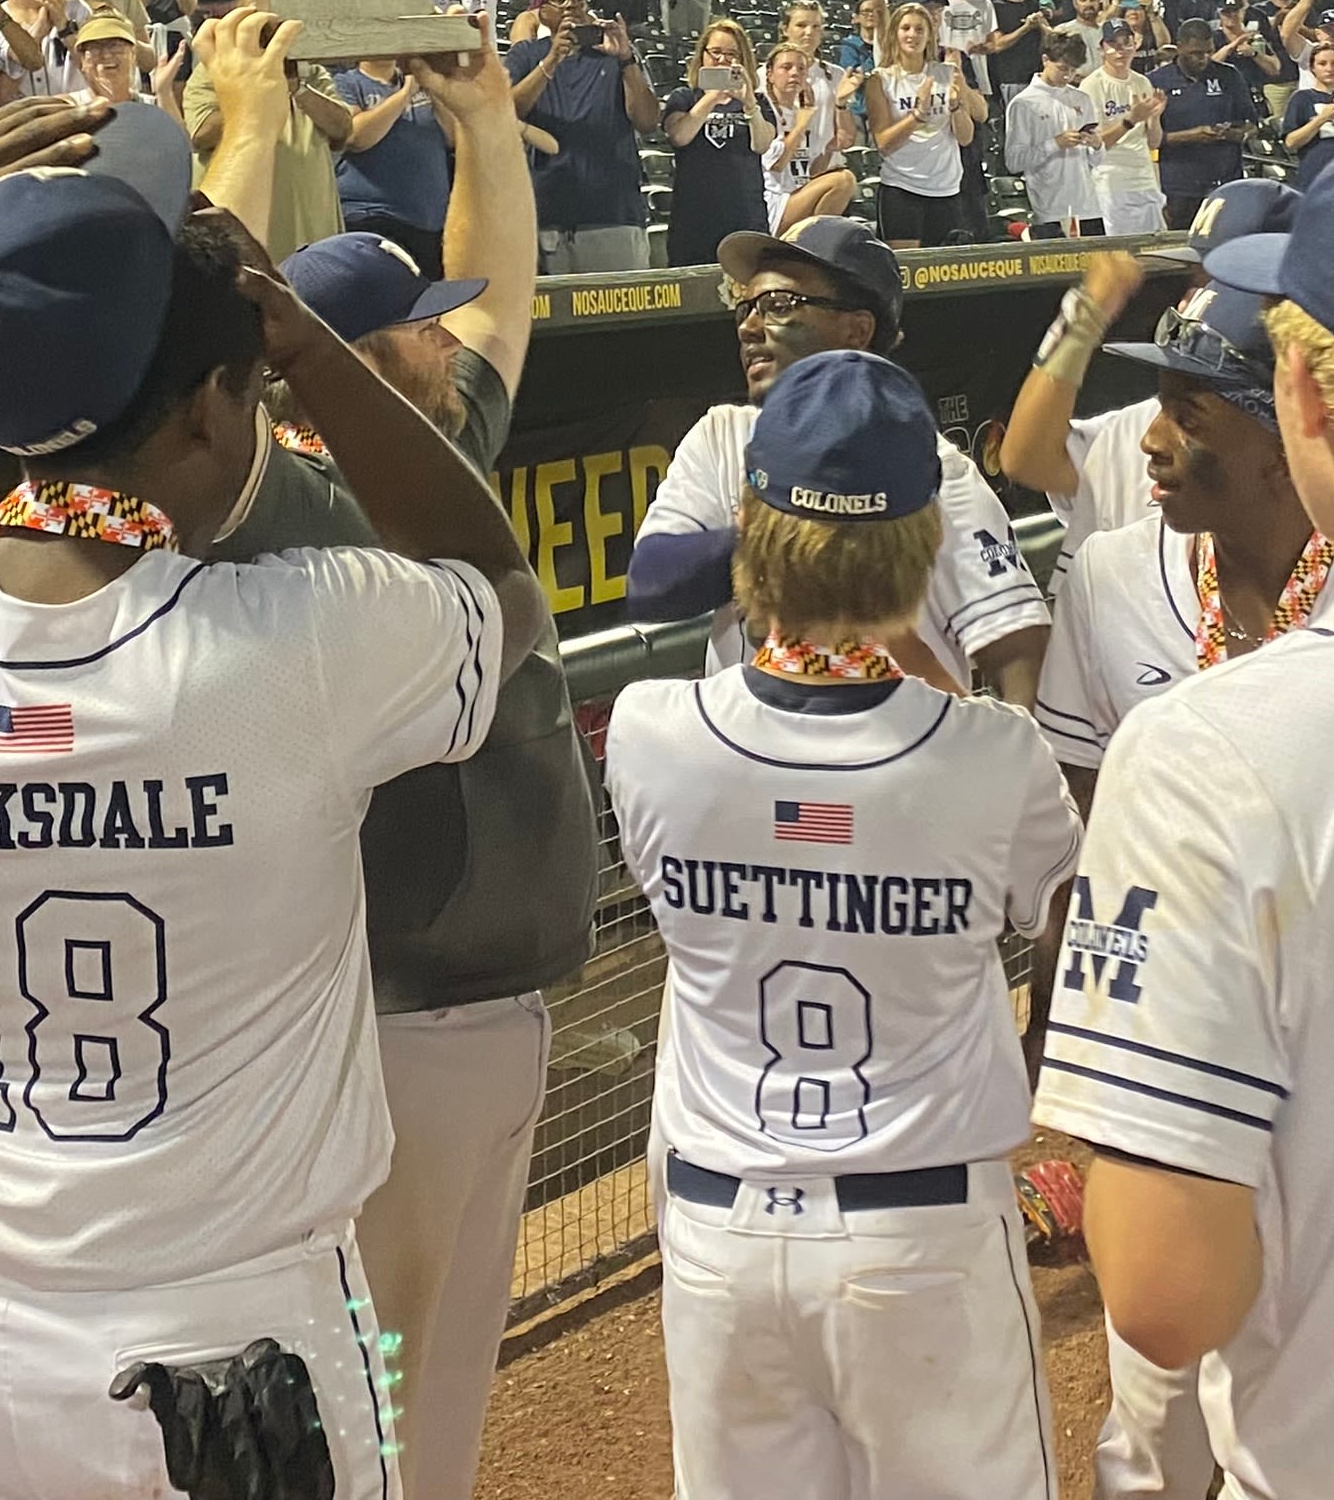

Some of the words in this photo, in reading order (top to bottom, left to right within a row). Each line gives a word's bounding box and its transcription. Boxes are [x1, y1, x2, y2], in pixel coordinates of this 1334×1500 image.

[1206, 78, 1221, 93] M
[899, 93, 946, 110] NAY
[914, 258, 1023, 287] @NOSAUCEQUE
[571, 282, 682, 316] NOSAUCEQUE.COM
[938, 394, 969, 423] THE
[790, 486, 888, 514] COLONELS
[660, 855, 973, 937] SUETTINGER
[1064, 874, 1159, 1005] M
[754, 960, 873, 1152] 8
